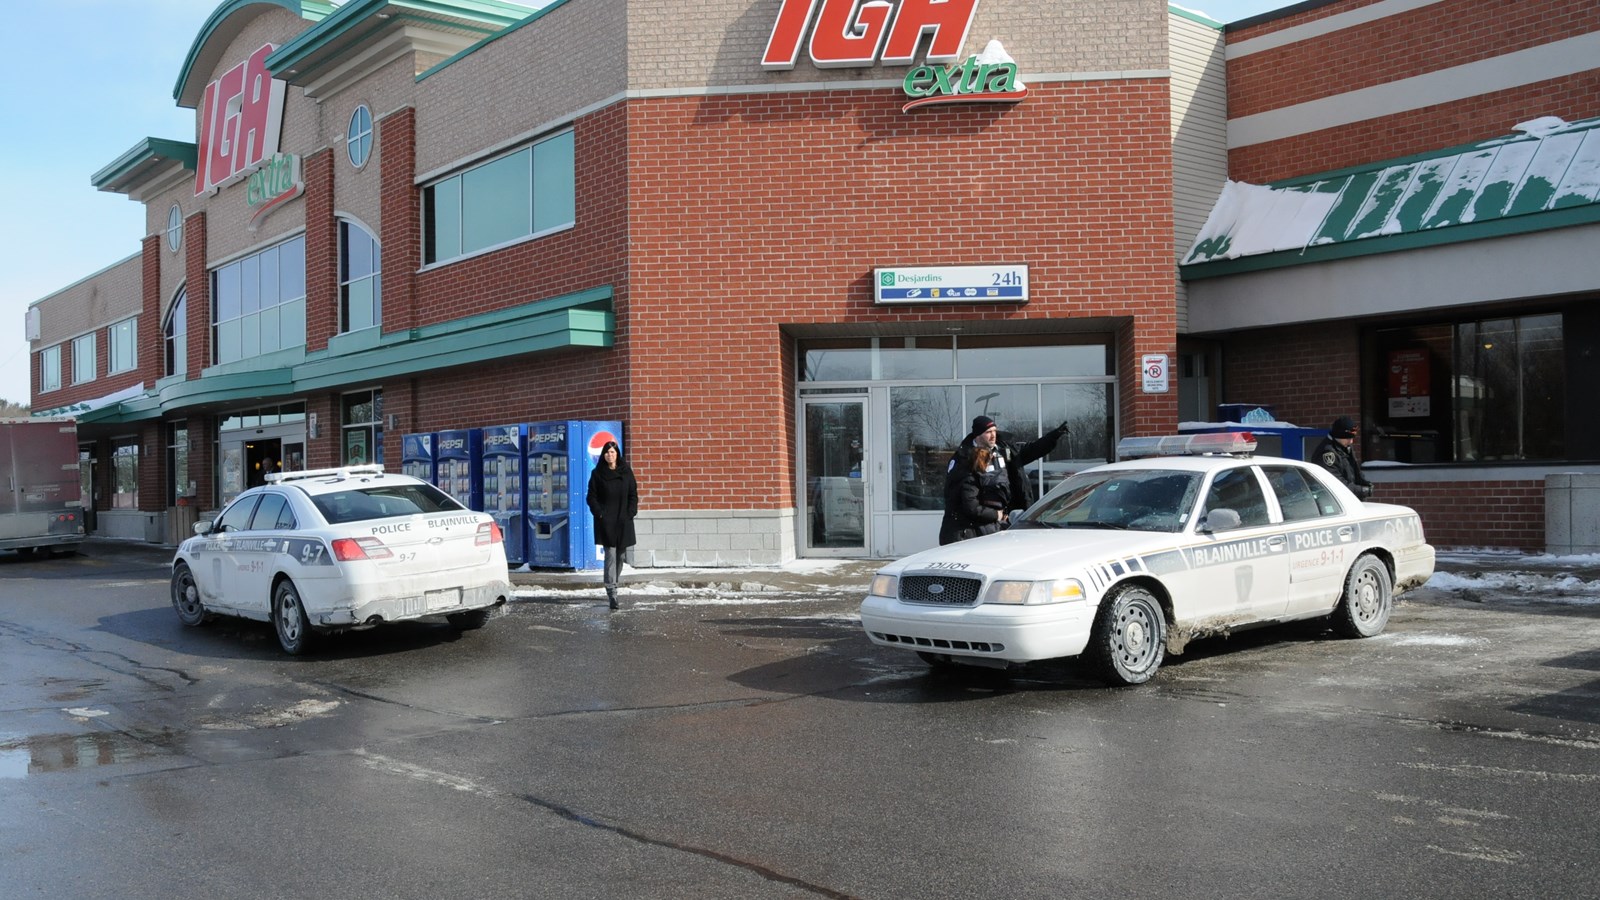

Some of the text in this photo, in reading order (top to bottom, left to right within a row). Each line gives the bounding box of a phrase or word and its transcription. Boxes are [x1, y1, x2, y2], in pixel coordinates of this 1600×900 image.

[902, 55, 1018, 98] extra
[194, 42, 275, 197] IGA
[247, 152, 293, 207] extra
[897, 271, 1022, 286] Desjardins 24h
[442, 439, 464, 449] PEPSI
[534, 433, 560, 443] PEPSI
[428, 516, 479, 528] BLAINVILLE
[371, 523, 411, 535] POLICE
[235, 540, 264, 551] BLAINVILLE
[1194, 529, 1333, 567] BLAINVILLE POLICE
[301, 543, 324, 563] 9-7
[399, 552, 417, 562] 9-7
[1320, 548, 1344, 566] 9-1-1
[251, 560, 264, 572] 9-1-1
